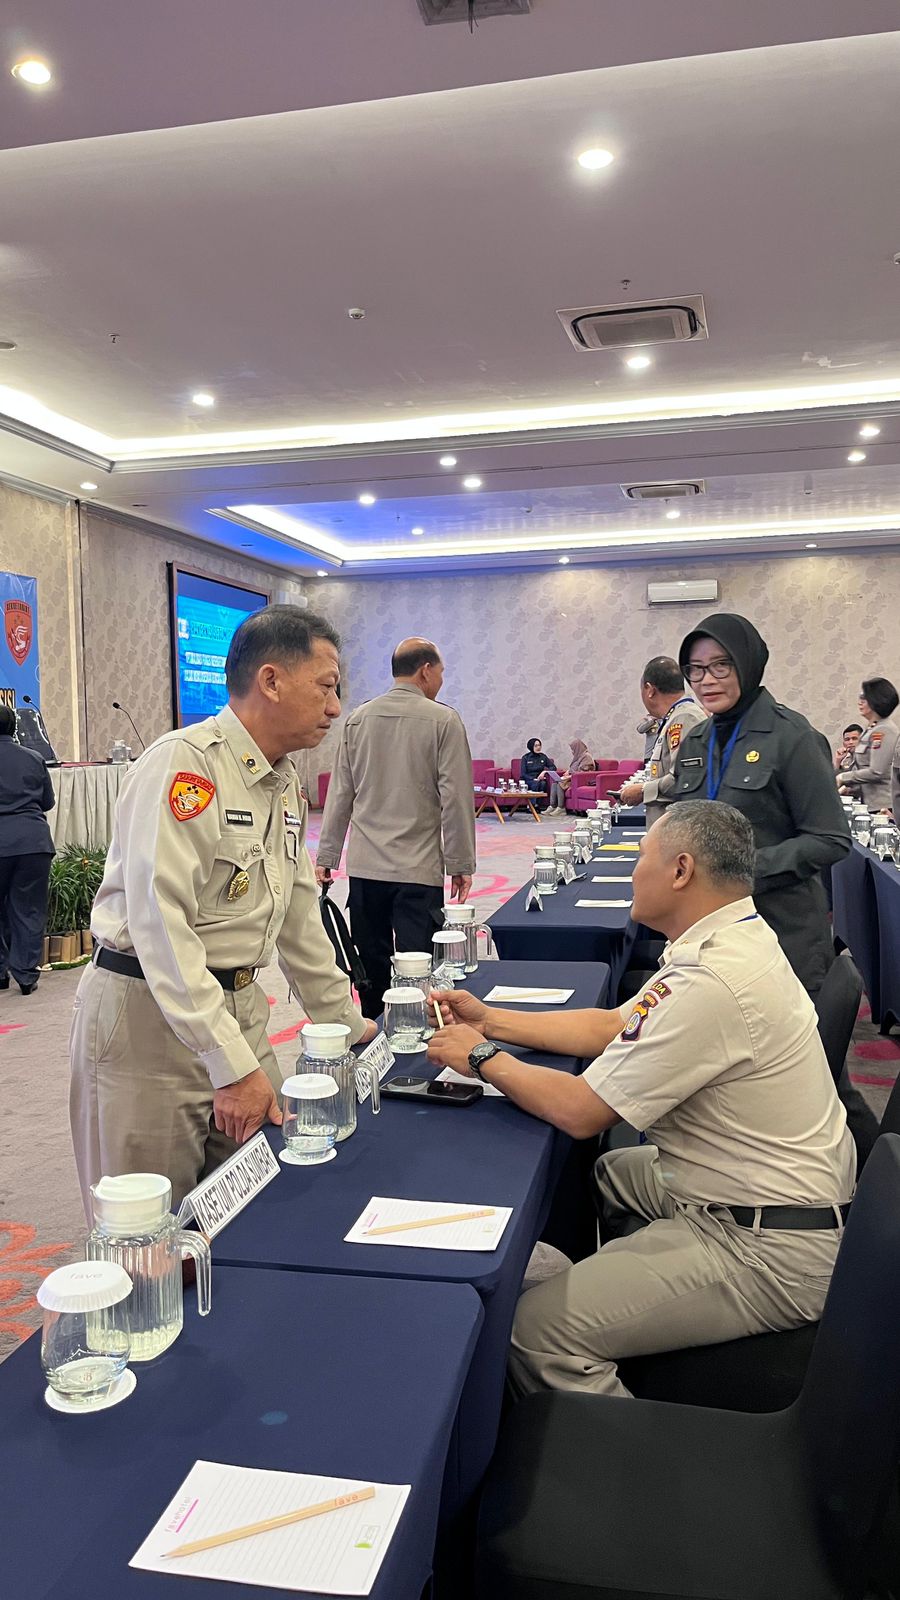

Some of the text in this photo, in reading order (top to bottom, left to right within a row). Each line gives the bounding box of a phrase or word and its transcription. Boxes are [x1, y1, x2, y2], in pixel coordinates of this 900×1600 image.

[195, 1141, 276, 1232] KASETUM POLDA SUMBAR
